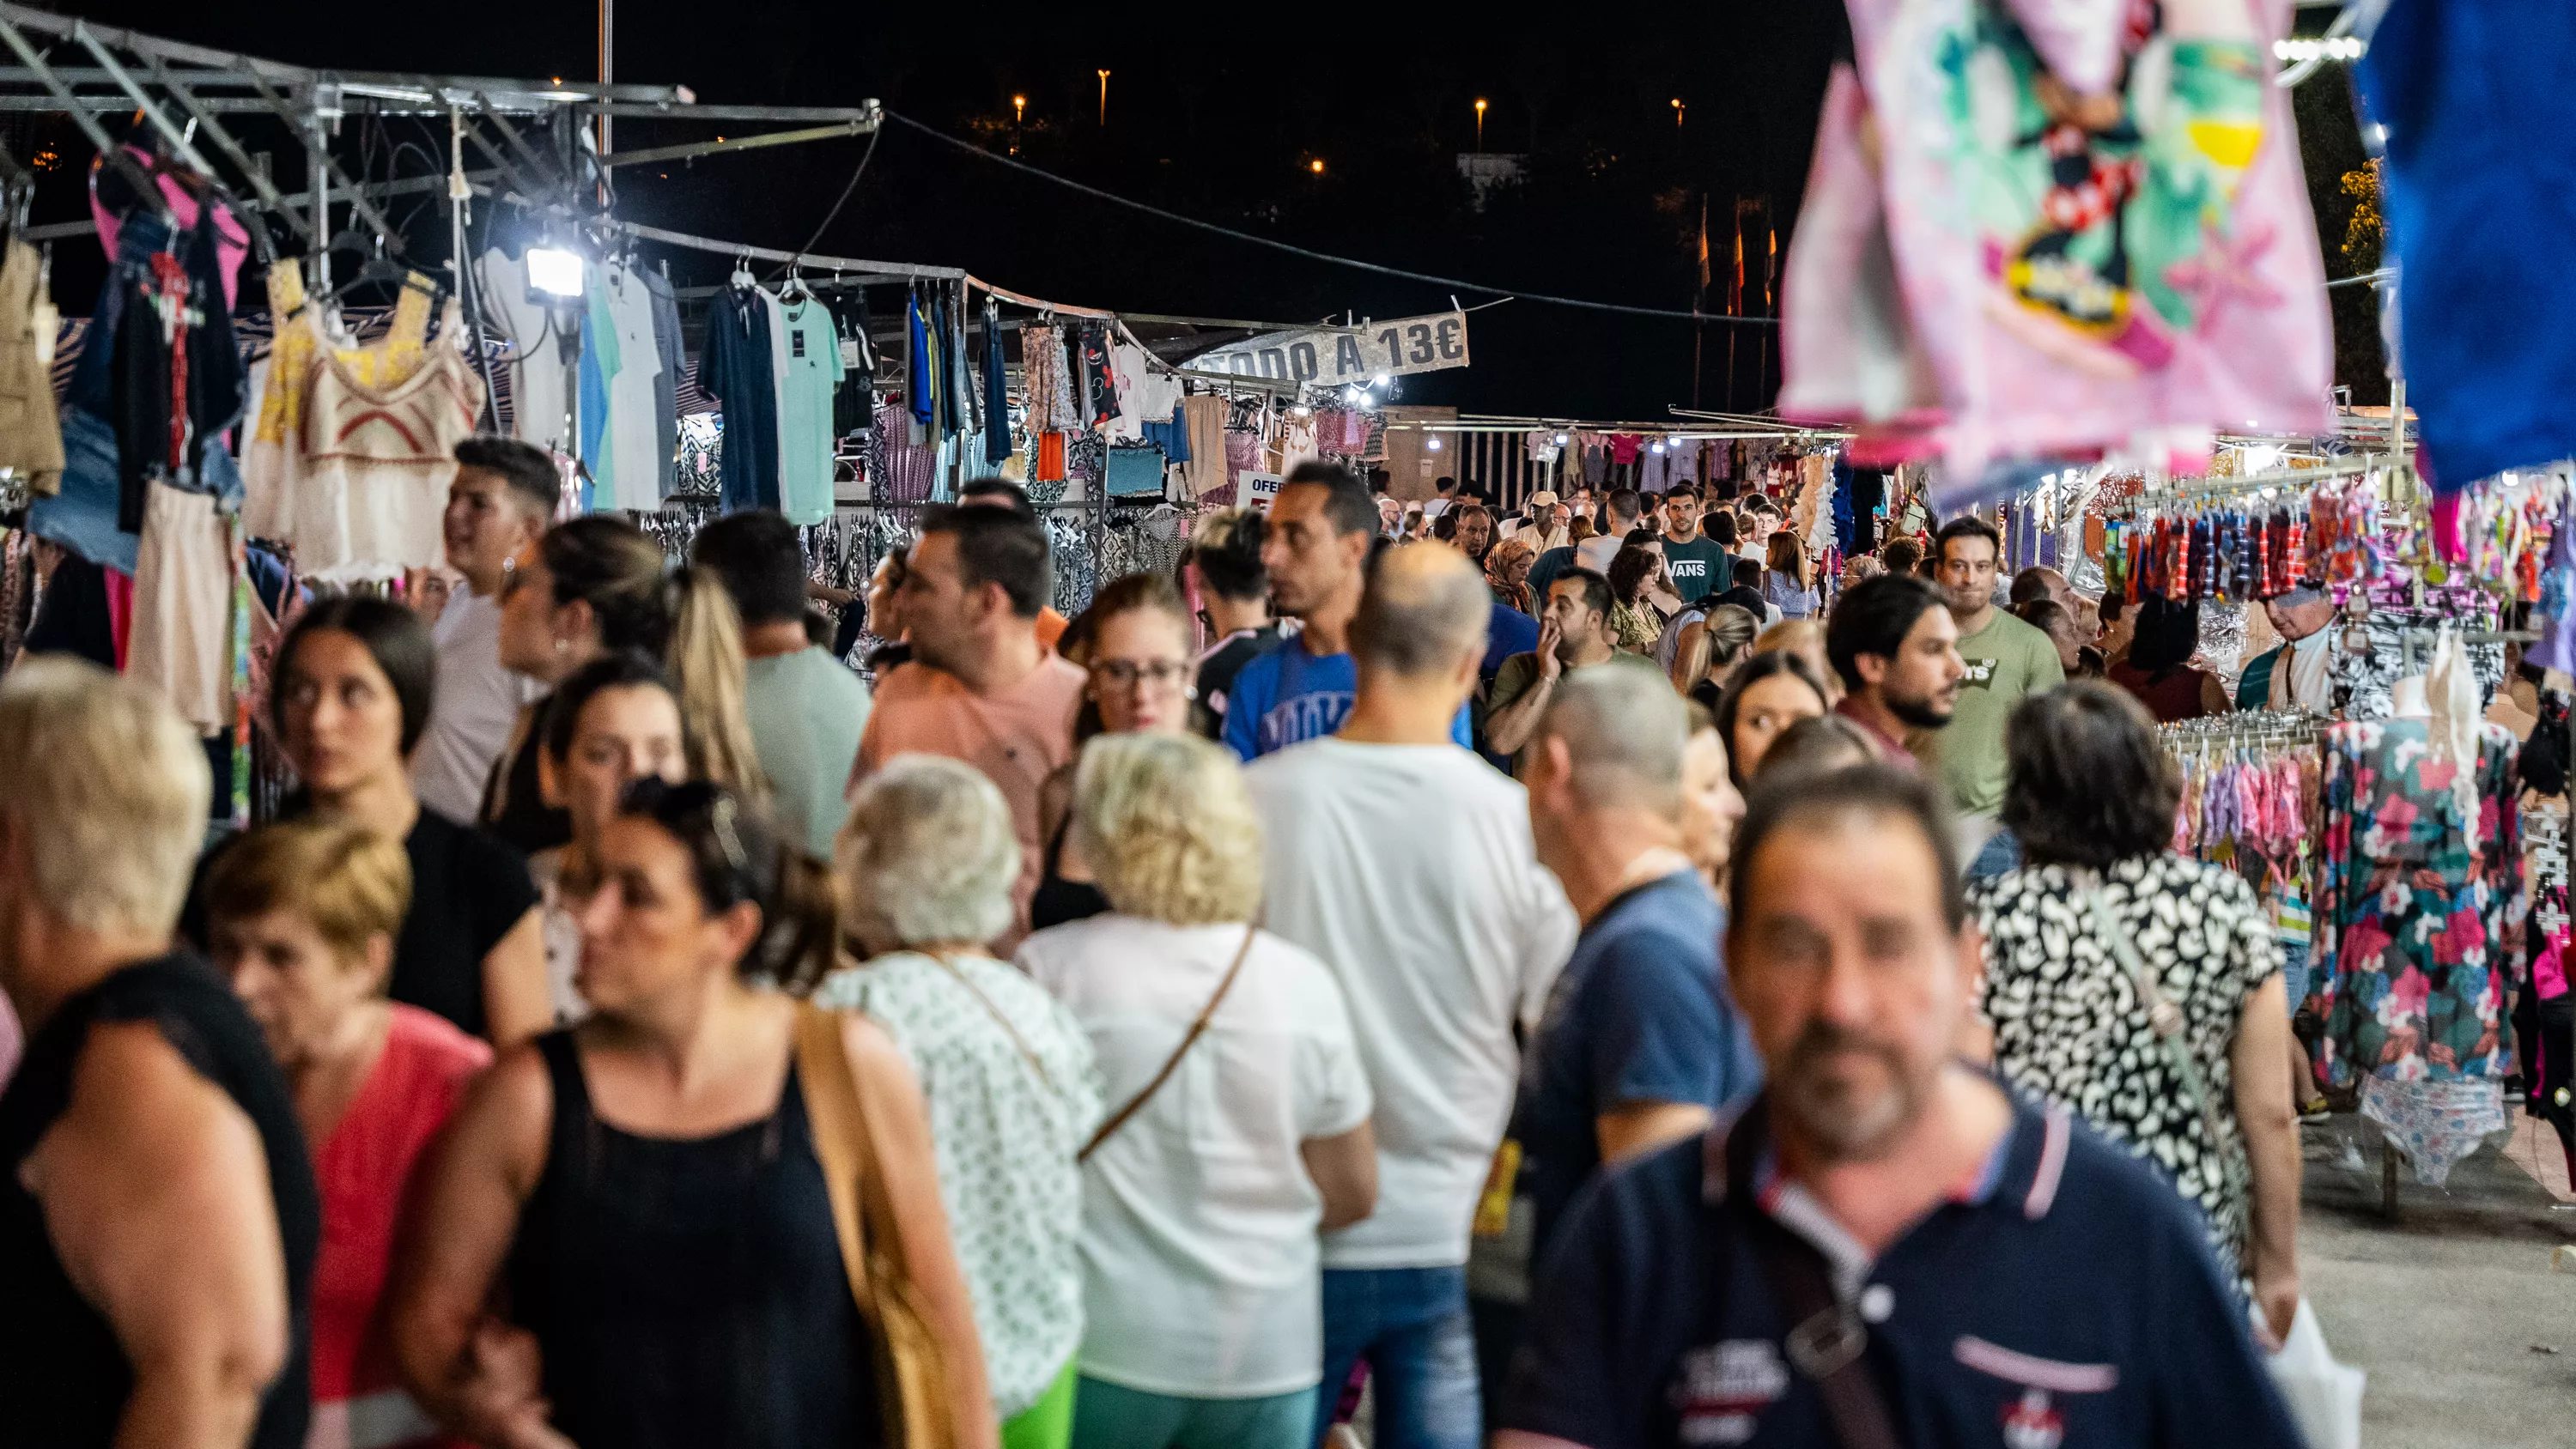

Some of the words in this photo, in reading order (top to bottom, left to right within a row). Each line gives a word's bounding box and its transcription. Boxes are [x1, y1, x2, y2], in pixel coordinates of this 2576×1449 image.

[1337, 335, 1365, 376] A
[1377, 318, 1463, 367] 13€
[1252, 478, 1285, 494] OFER
[1669, 560, 1706, 577] VANS
